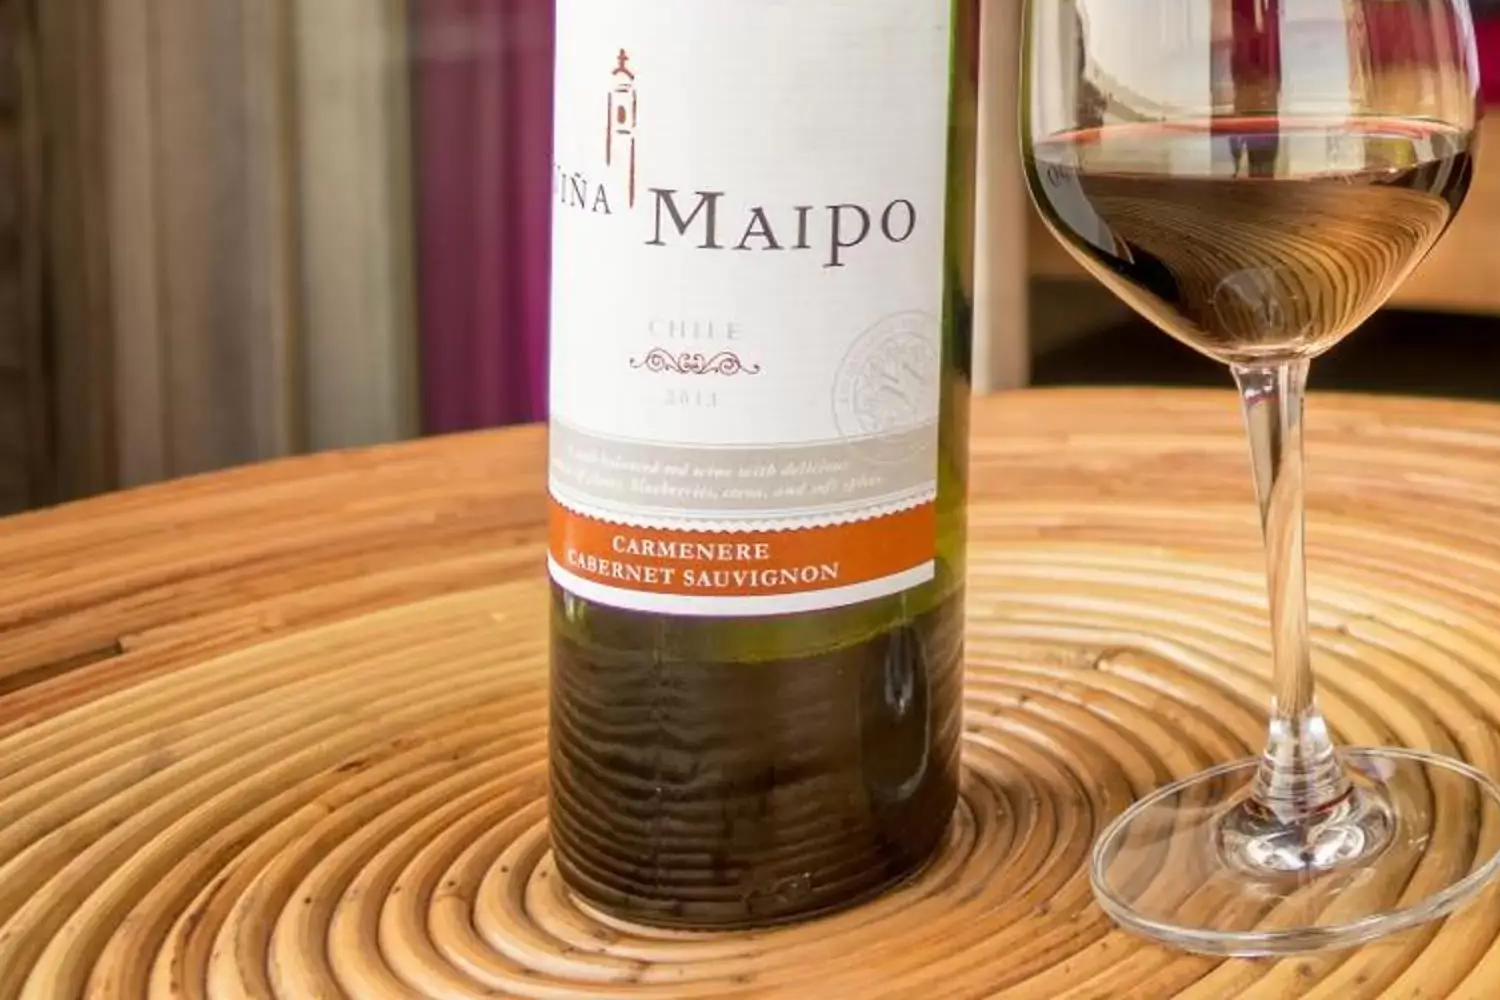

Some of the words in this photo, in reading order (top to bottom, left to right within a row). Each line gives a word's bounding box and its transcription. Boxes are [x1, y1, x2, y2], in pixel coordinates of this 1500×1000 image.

[554, 164, 613, 215] IÑA
[648, 317, 743, 341] CHILE
[692, 461, 733, 480] wine
[737, 462, 777, 479] with
[611, 534, 770, 561] CARMENERE
[567, 547, 677, 585] CABERNET
[682, 561, 840, 588] SAUVIGNON
